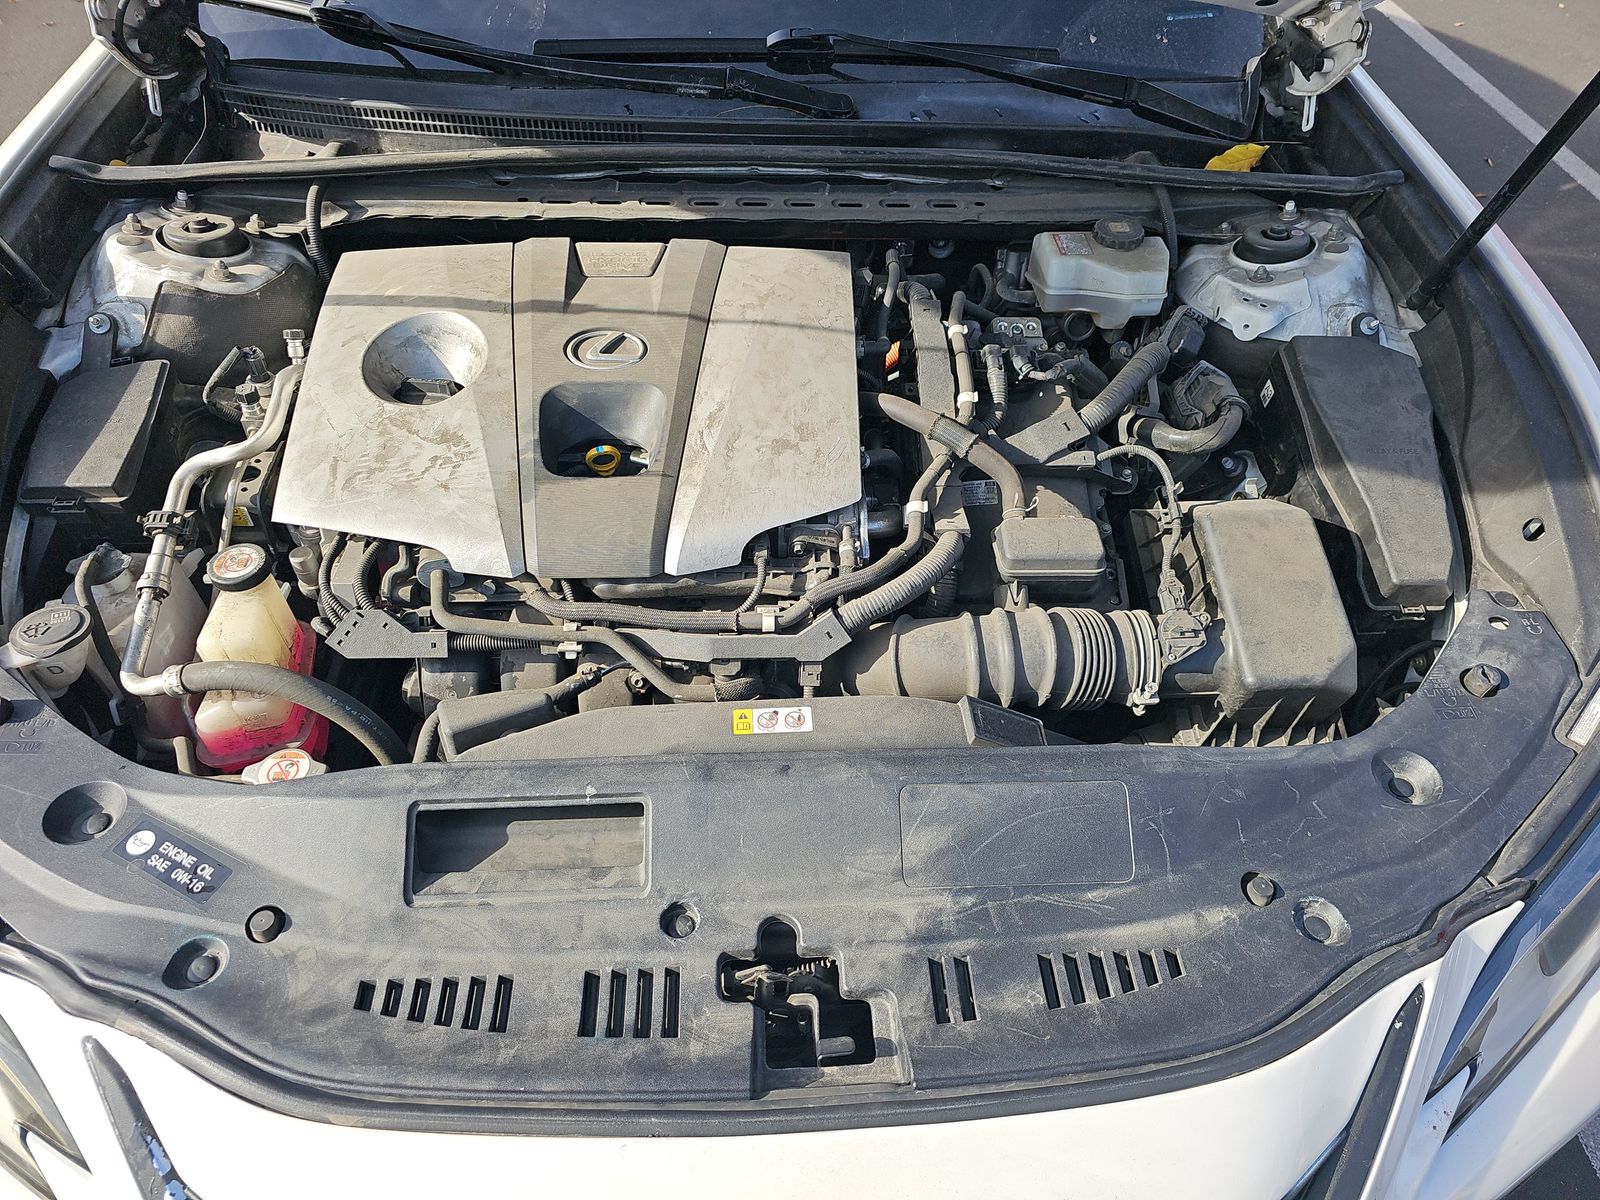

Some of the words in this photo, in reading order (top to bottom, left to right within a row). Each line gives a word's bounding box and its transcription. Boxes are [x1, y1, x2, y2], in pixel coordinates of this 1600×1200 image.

[147, 854, 171, 873] SAE
[171, 868, 205, 893] 0W-16
[158, 841, 197, 868] ENGINE
[196, 863, 215, 880] OIL
